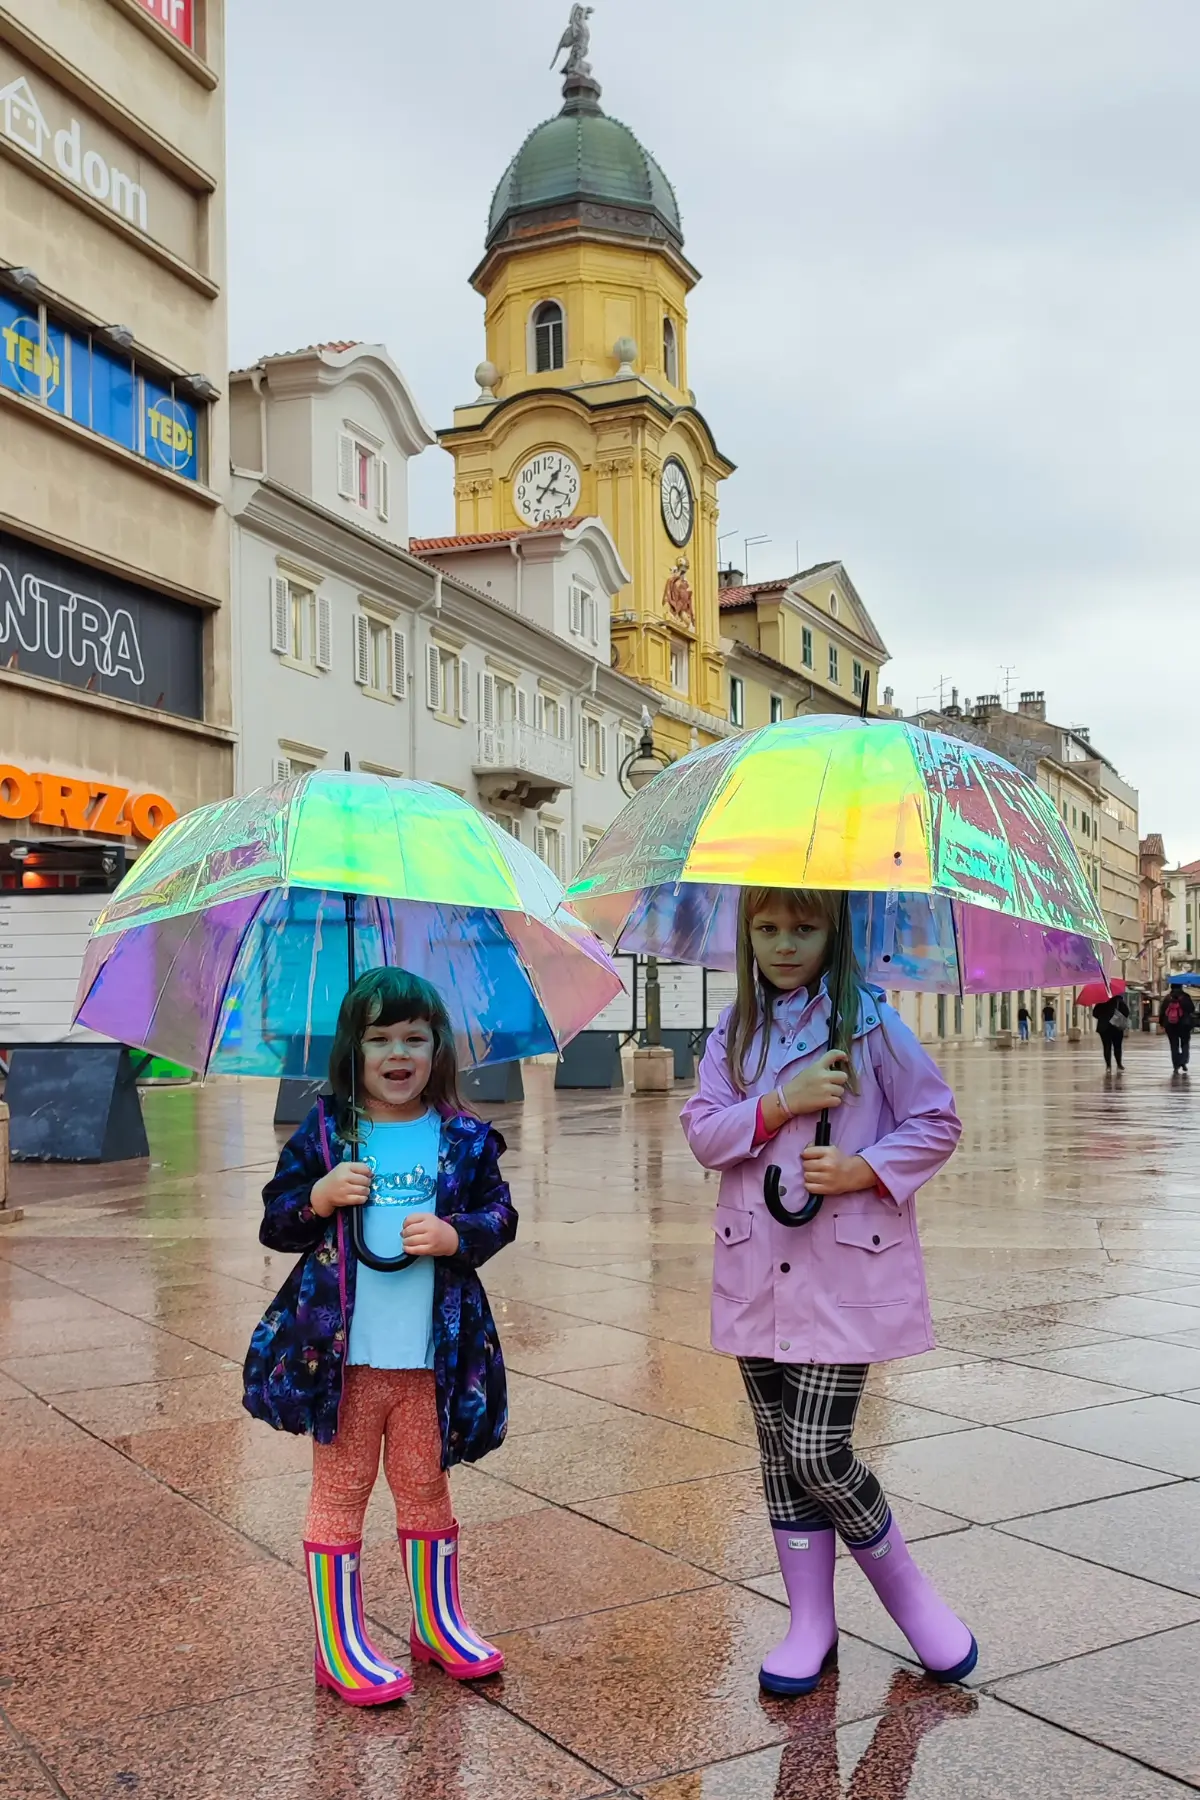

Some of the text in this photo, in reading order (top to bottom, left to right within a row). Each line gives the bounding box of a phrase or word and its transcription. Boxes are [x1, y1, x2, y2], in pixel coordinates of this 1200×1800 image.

[54, 118, 148, 231] dom
[2, 326, 60, 386] TEDi
[148, 407, 193, 457] TEDi
[533, 460, 540, 475] 11
[543, 456, 554, 470] 12
[522, 469, 533, 483] 10
[563, 464, 571, 478] 2
[517, 485, 526, 500] 9
[569, 478, 577, 493] 3
[523, 500, 531, 514] 8
[533, 508, 541, 522] 7
[0, 562, 146, 686] NTRA
[0, 763, 178, 841] ORZO
